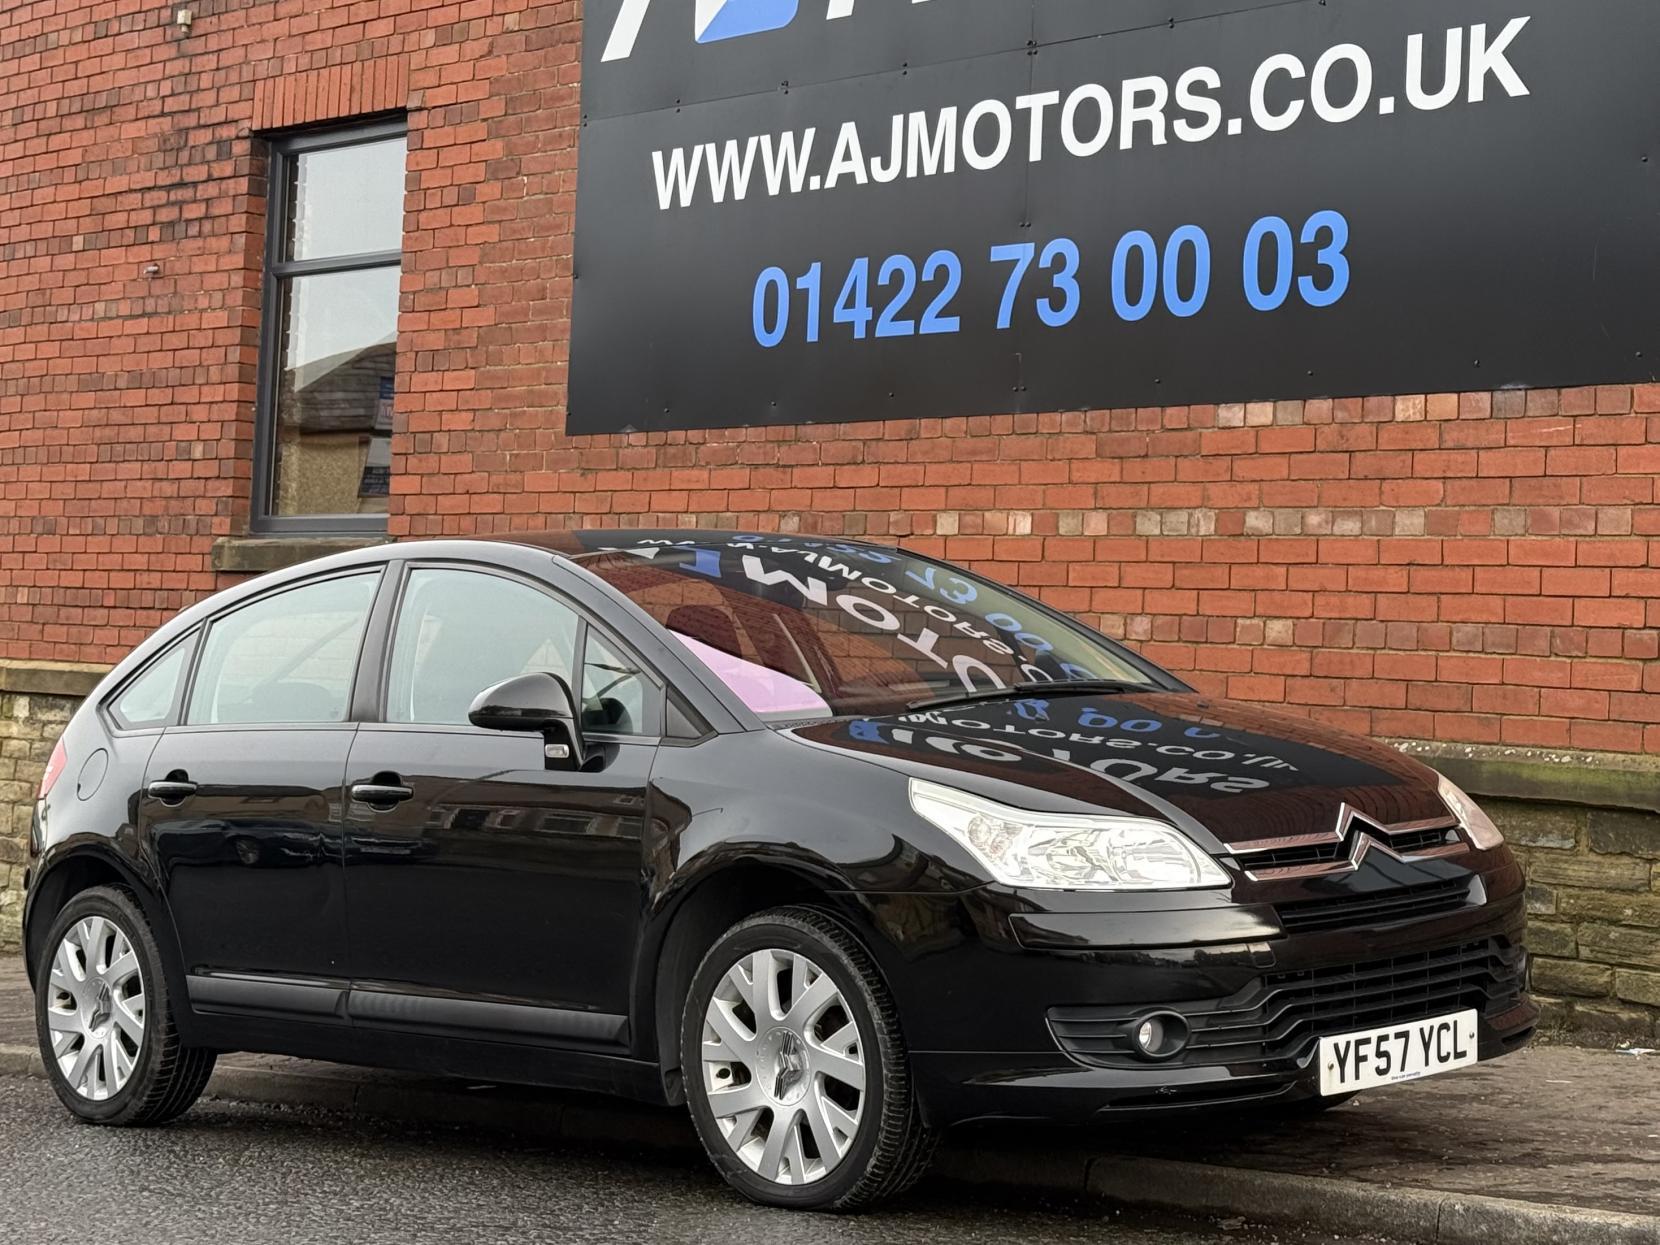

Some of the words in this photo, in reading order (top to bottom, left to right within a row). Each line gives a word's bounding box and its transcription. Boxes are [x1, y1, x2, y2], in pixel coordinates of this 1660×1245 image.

[651, 16, 1531, 211] WWW.AJMOTORS.CO.UK
[752, 249, 962, 348] 01422
[989, 237, 1081, 330] 73
[1110, 224, 1211, 322] 00
[1242, 209, 1350, 312] 03
[1333, 1030, 1410, 1084] YF57
[1419, 1019, 1468, 1067] YCL
